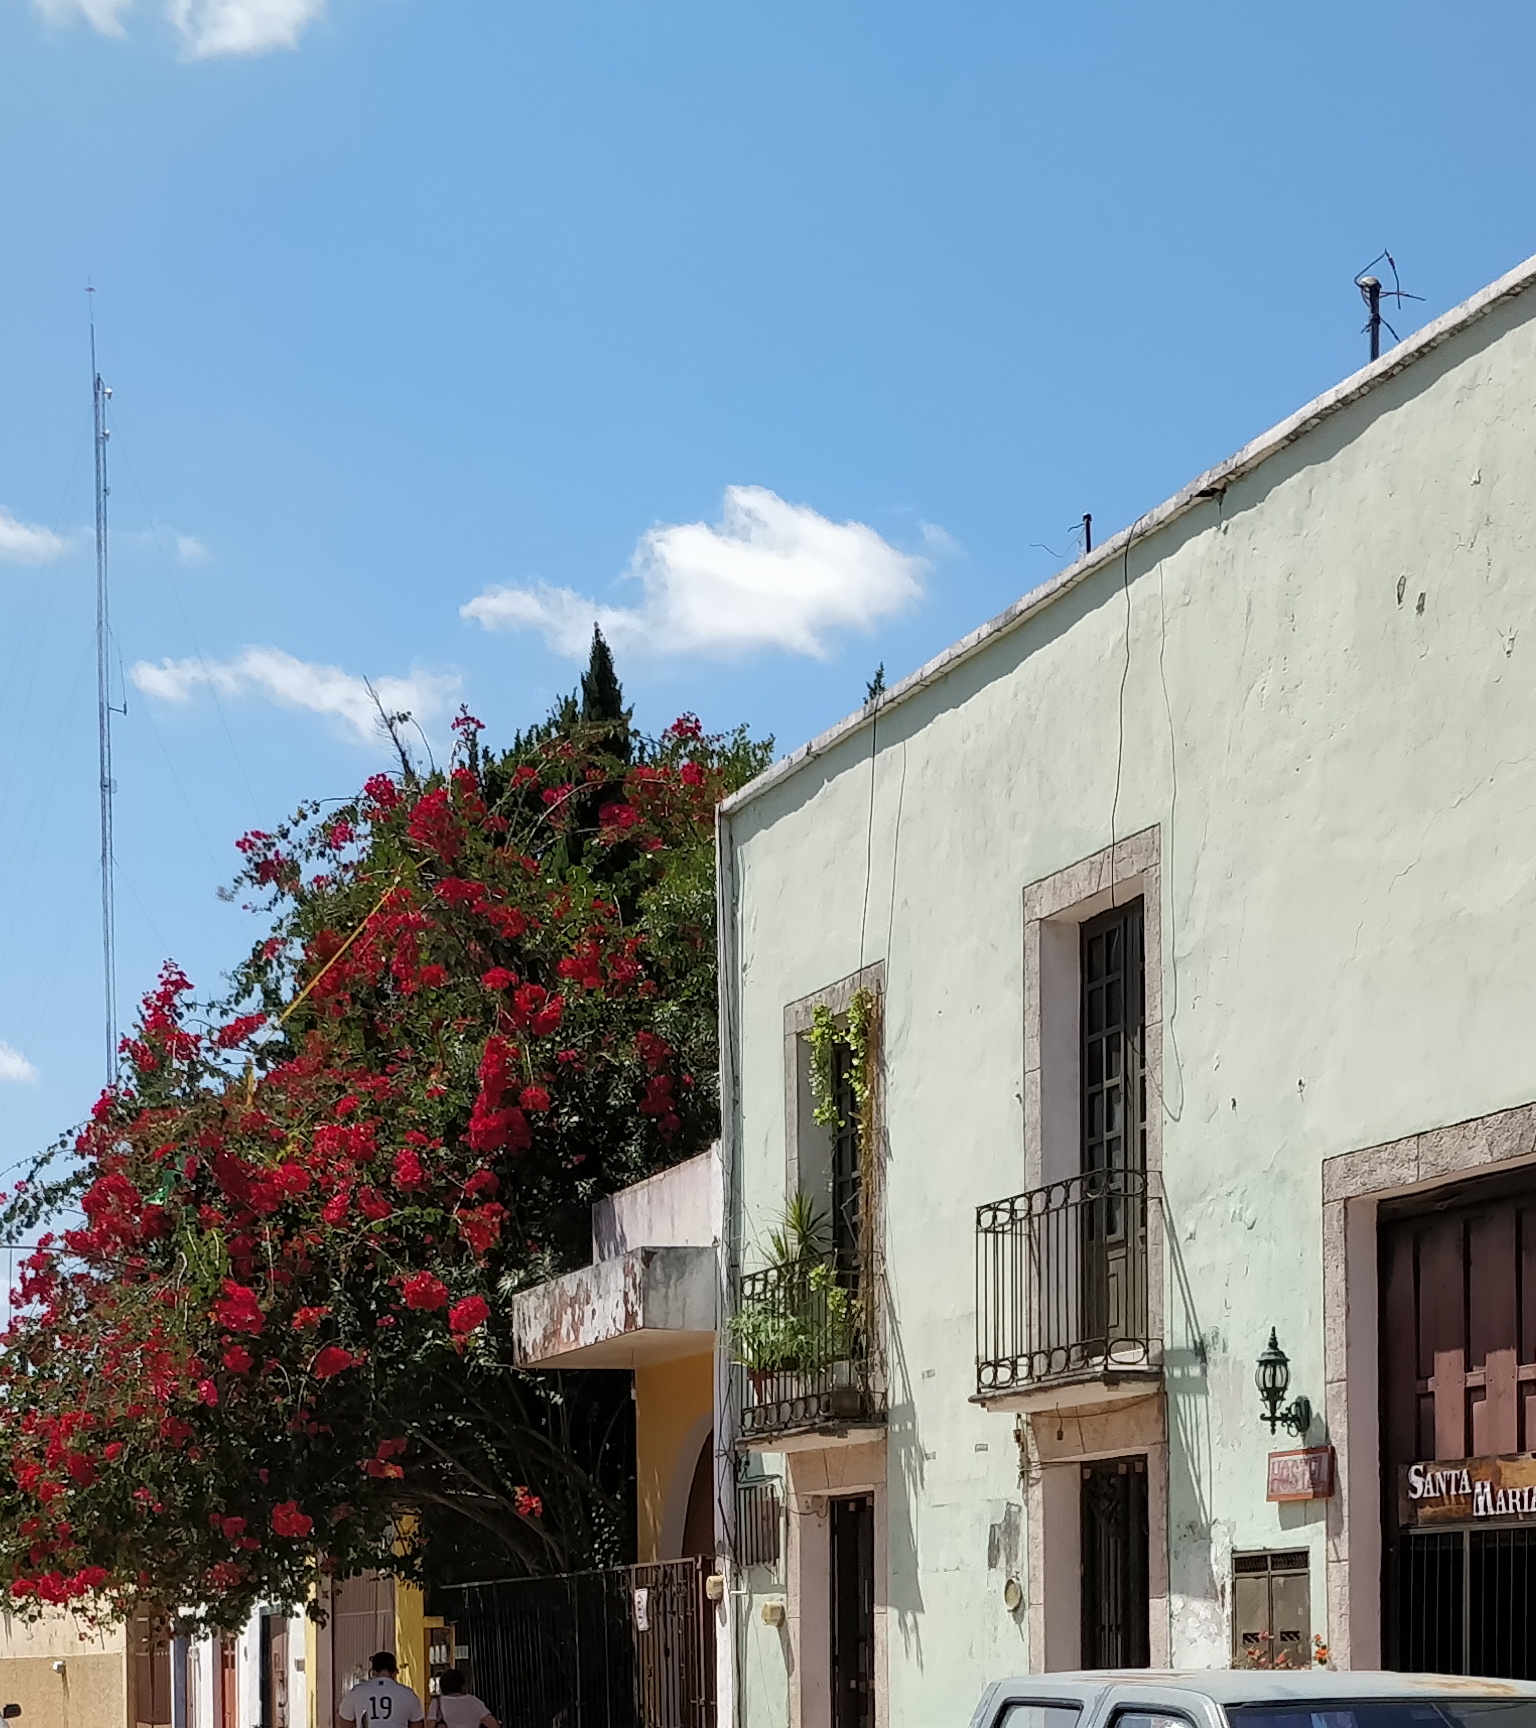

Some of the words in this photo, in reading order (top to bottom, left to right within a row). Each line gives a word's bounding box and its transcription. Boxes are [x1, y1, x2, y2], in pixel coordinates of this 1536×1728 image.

[1270, 1456, 1329, 1493] HOSTEL
[1408, 1464, 1472, 1499] SANTA
[369, 1696, 392, 1720] 19
